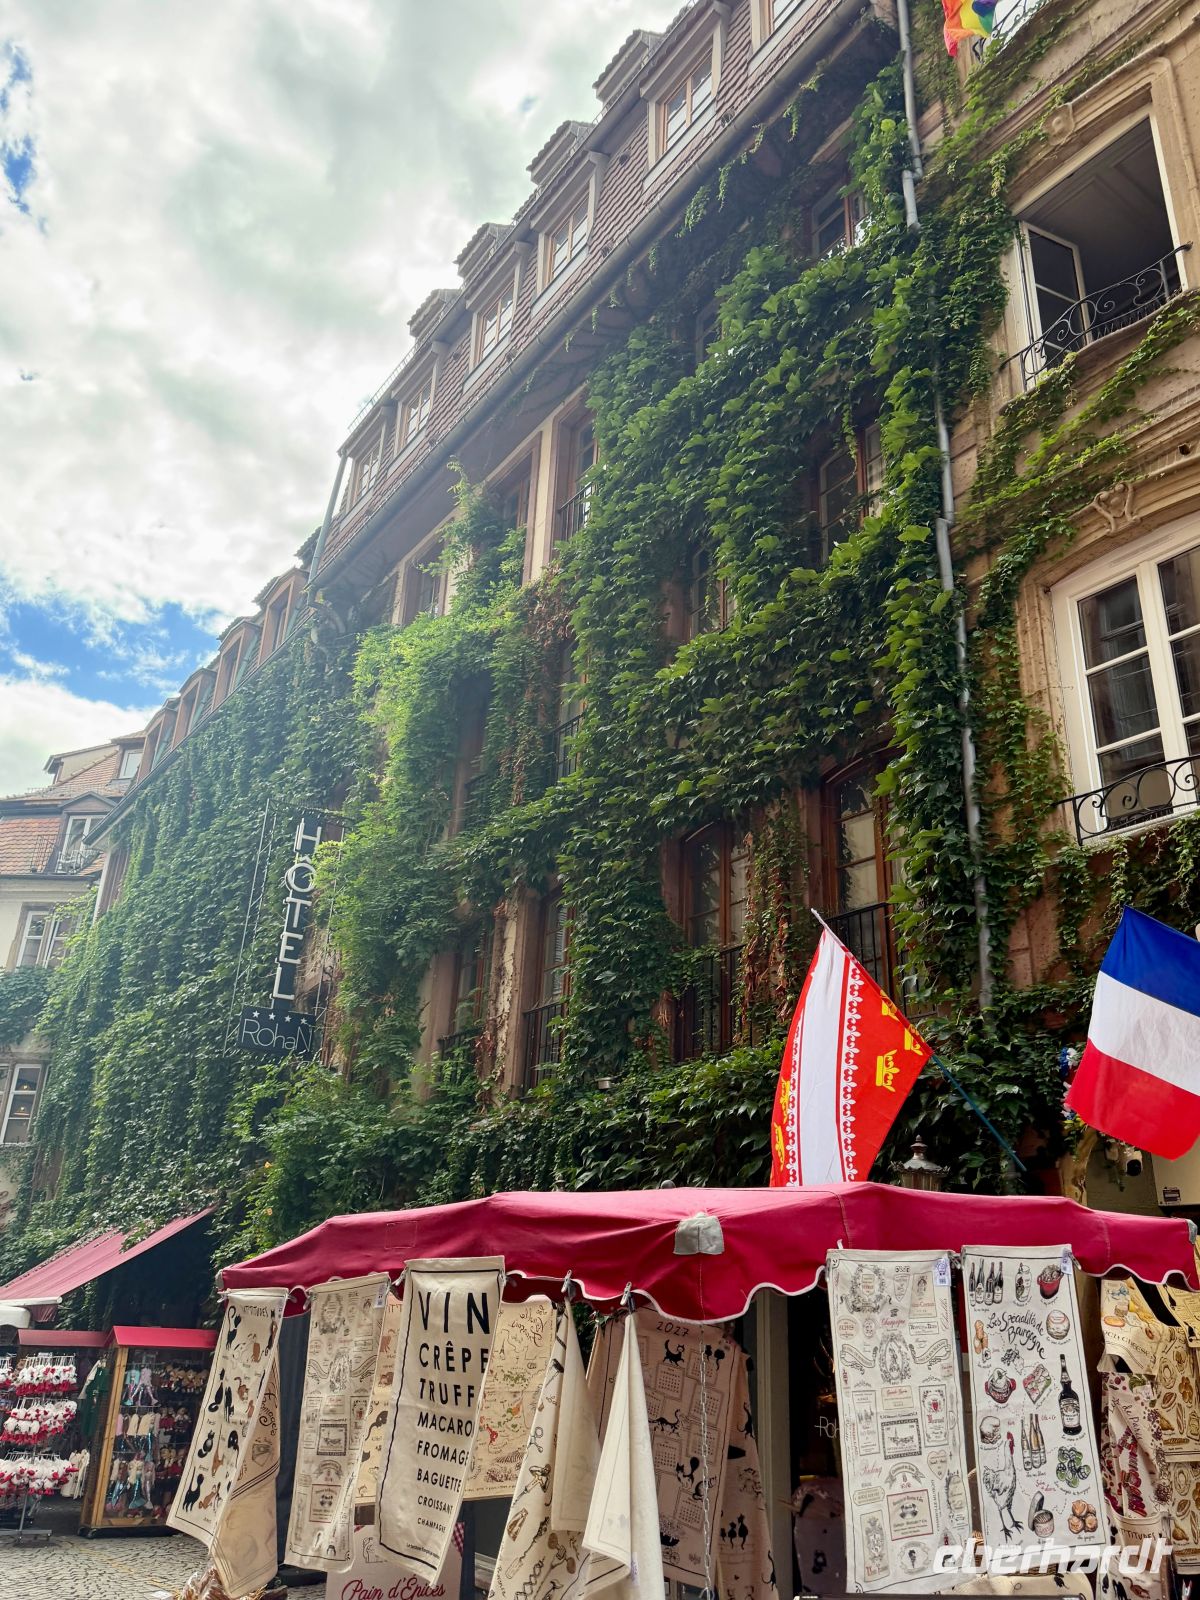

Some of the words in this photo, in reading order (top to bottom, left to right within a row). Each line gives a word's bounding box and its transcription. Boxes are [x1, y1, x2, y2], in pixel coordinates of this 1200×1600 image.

[272, 818, 322, 1001] HÔTEL
[418, 1291, 490, 1334] VIN
[656, 1321, 690, 1337] 2027
[419, 1340, 490, 1374] CRÊPE
[420, 1378, 475, 1408] TRUFF
[417, 1411, 475, 1438] MACARO
[417, 1469, 462, 1494] BAGUETTE
[417, 1495, 454, 1515] CROISSANT
[341, 1578, 384, 1600] Pain
[388, 1573, 446, 1600] d'Épices
